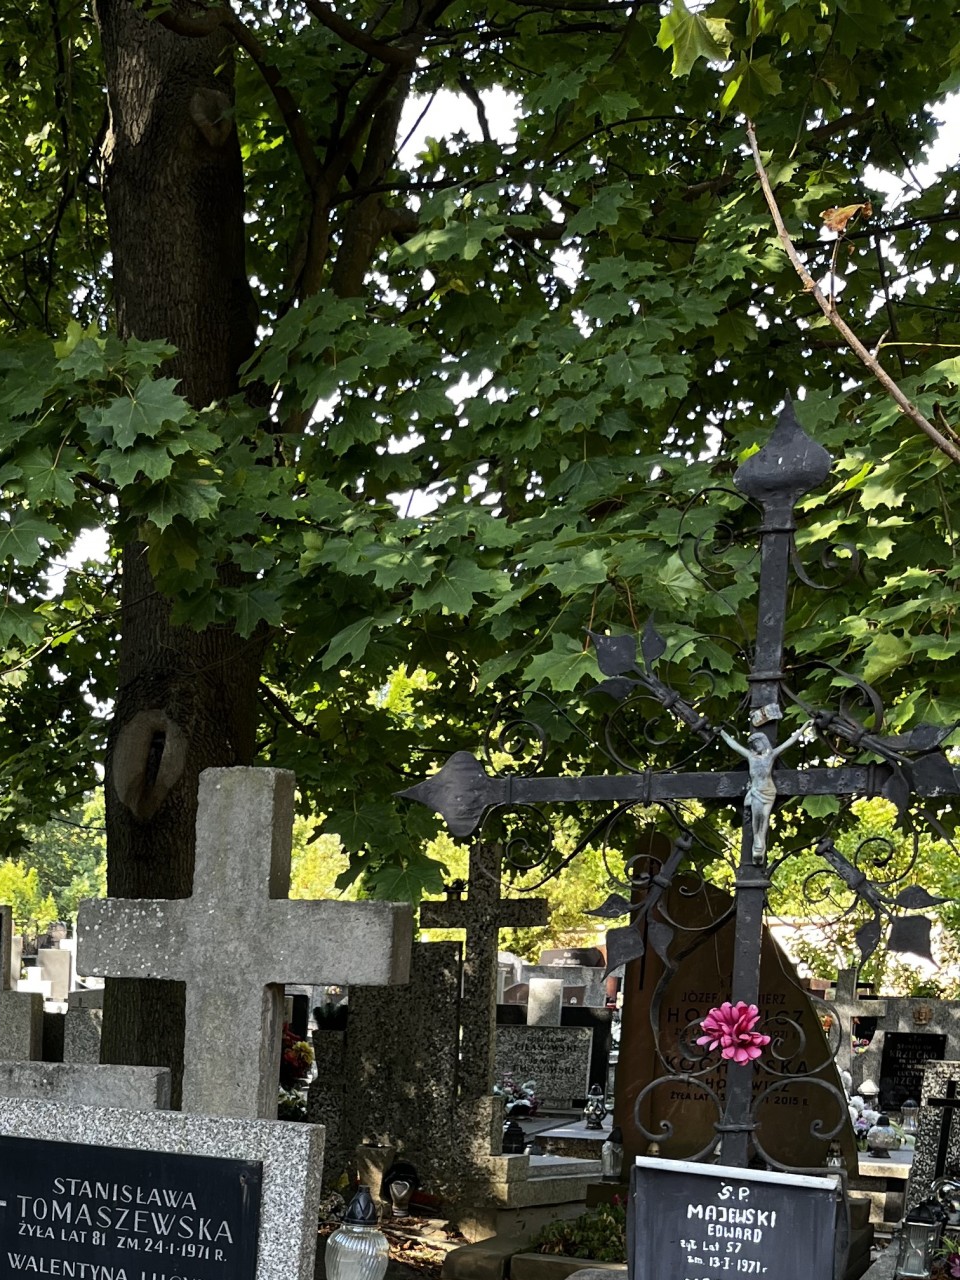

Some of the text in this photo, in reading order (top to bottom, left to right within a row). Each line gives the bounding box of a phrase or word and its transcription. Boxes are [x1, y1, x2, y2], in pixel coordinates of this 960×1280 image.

[774, 1096, 799, 1106] 2015
[52, 1177, 197, 1211] STANISŁAWA
[16, 1194, 233, 1244] TOMASZEWSKA
[686, 1203, 777, 1228] MAJEWSKI
[18, 1220, 55, 1240] ŻYŁA
[61, 1228, 87, 1244] LAT
[92, 1230, 106, 1246] 81
[117, 1236, 141, 1250] ZM.
[214, 1249, 227, 1262] R.
[707, 1223, 763, 1243] EDWARD
[726, 1241, 742, 1254] 57
